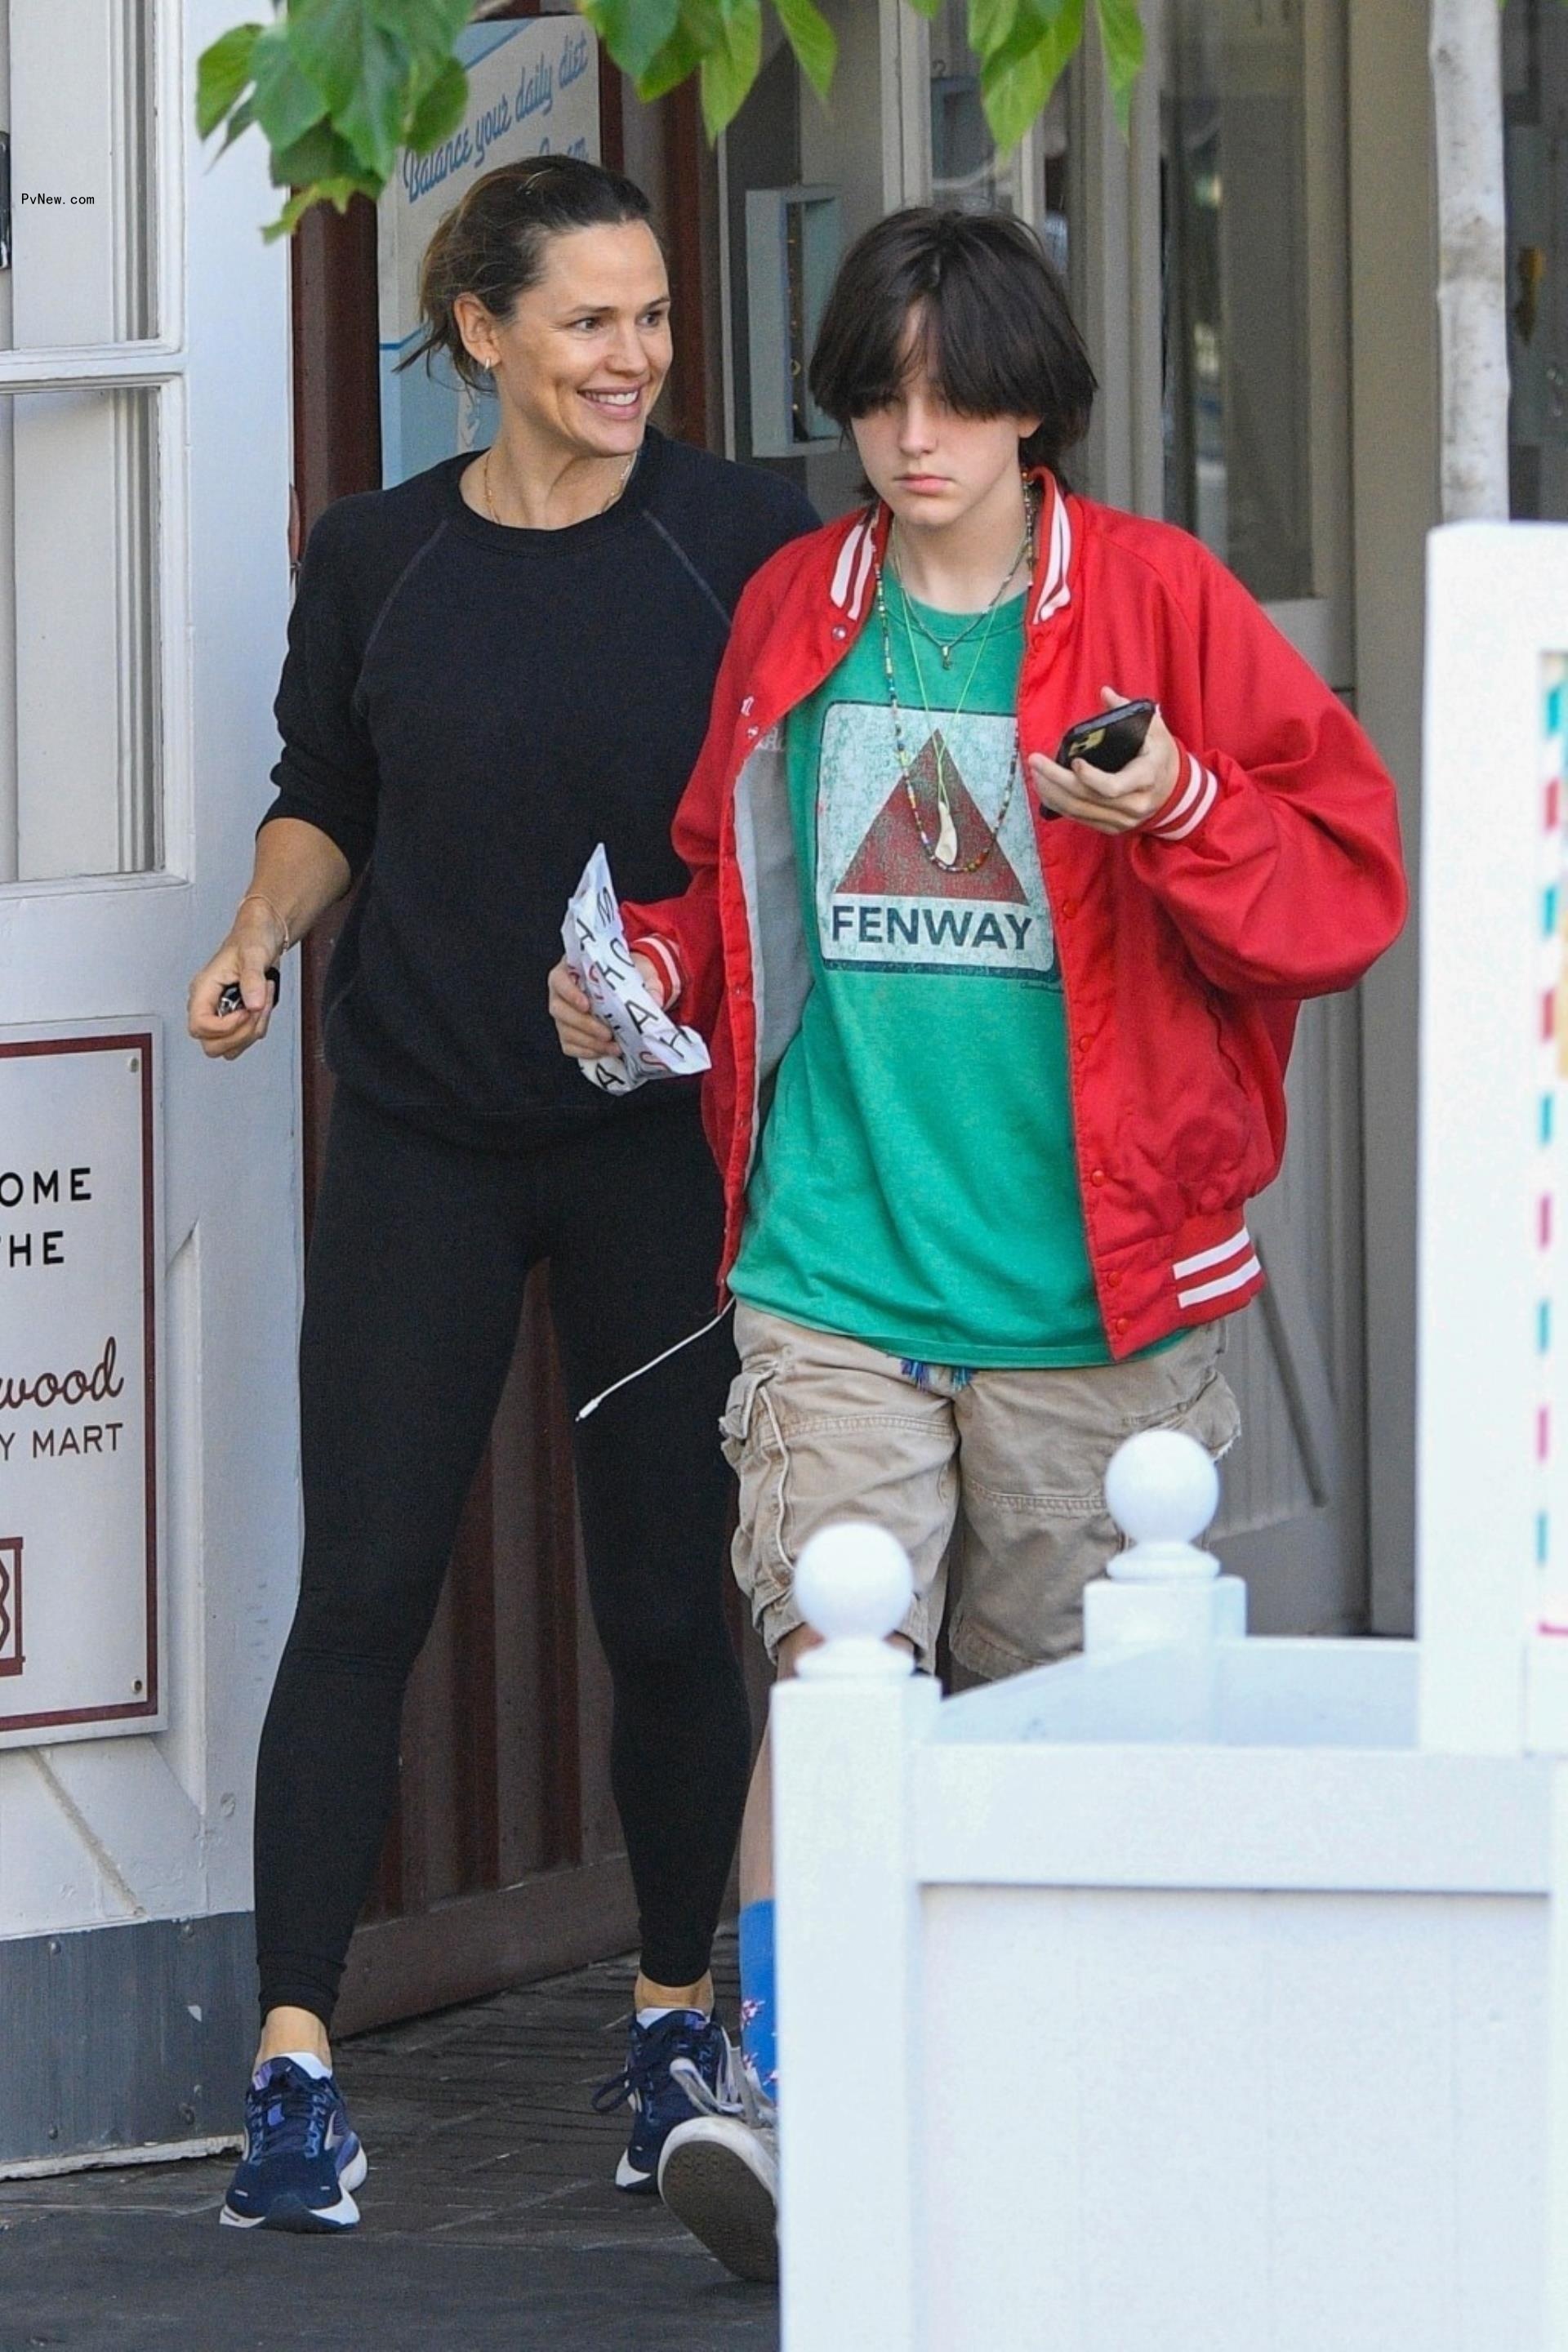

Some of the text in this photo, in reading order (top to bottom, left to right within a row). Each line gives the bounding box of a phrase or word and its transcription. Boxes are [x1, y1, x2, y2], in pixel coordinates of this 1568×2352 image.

[403, 30, 589, 203] Balance your daily diet
[832, 905, 1032, 951] FENWAY
[0, 1231, 65, 1267] HE
[33, 1423, 122, 1459] MART
